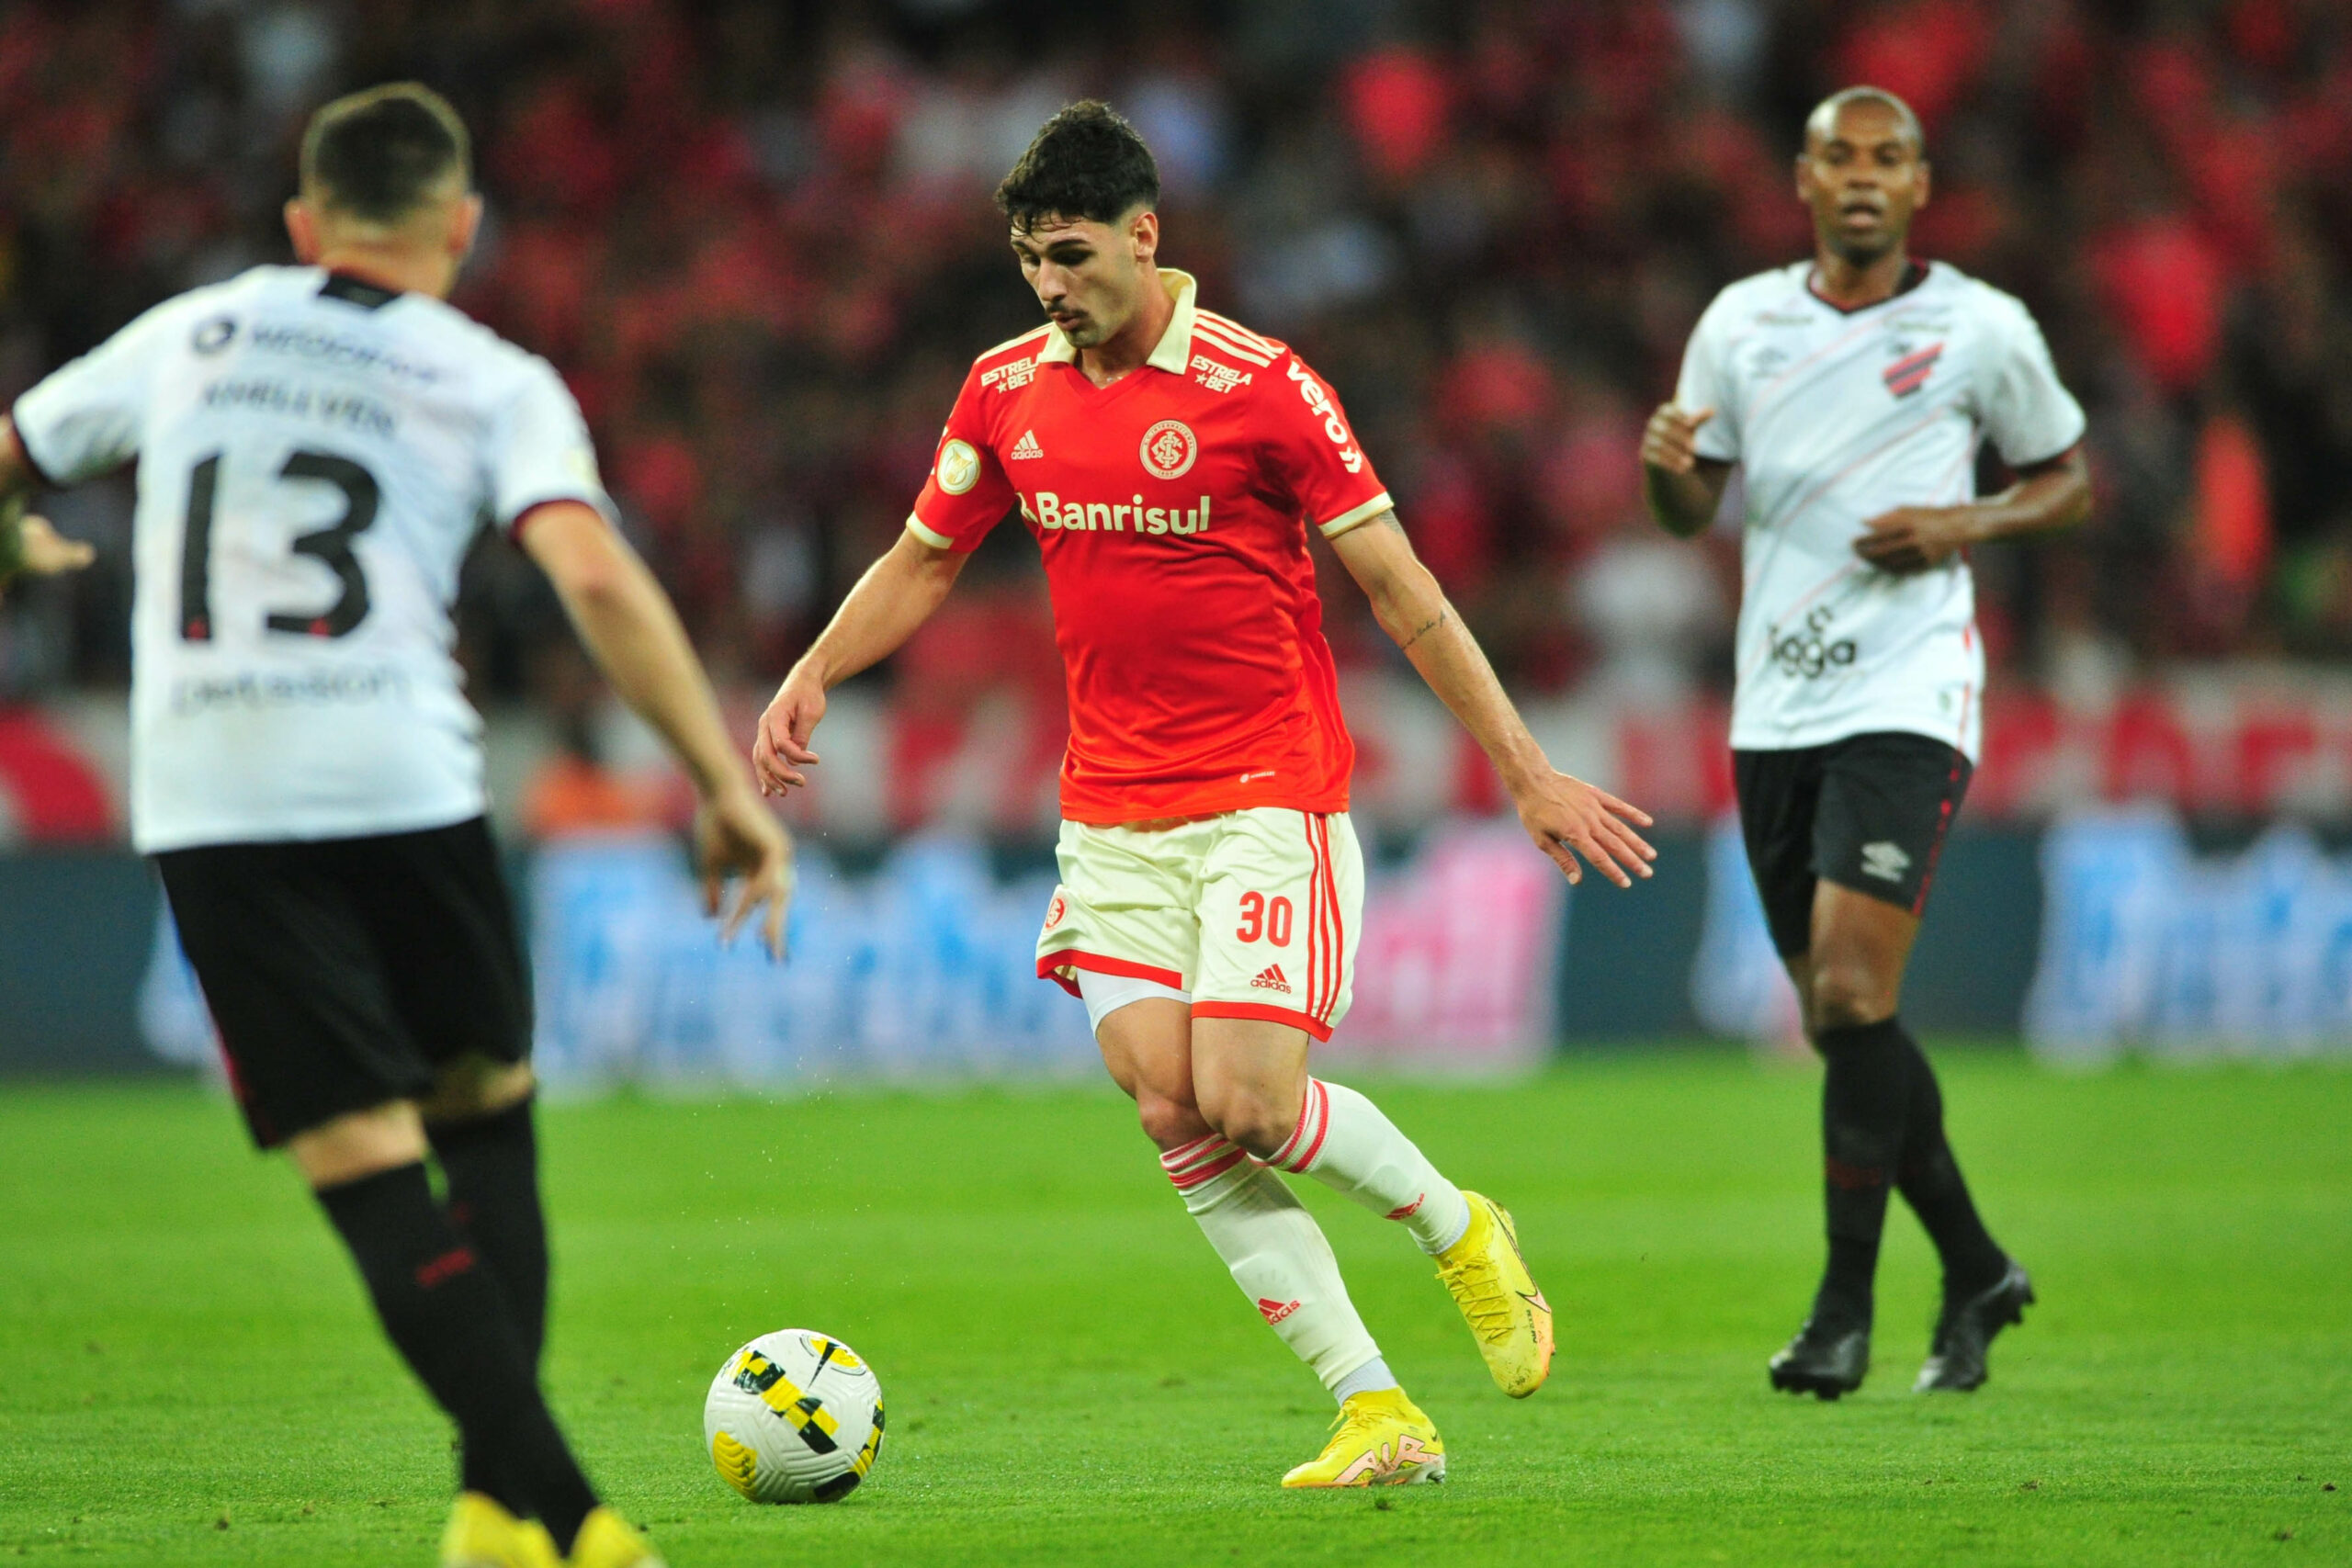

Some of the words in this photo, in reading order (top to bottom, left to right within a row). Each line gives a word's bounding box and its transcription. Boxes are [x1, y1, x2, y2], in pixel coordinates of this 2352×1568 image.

[1007, 367, 1036, 390] BET
[1190, 354, 1253, 386] ESTRELA
[1204, 374, 1238, 394] BET
[1286, 360, 1348, 445] vero
[1011, 448, 1044, 460] adidas
[1035, 491, 1211, 536] Banrisul
[180, 450, 381, 642] 13
[1236, 890, 1294, 948] 30
[1250, 977, 1293, 995] adidas
